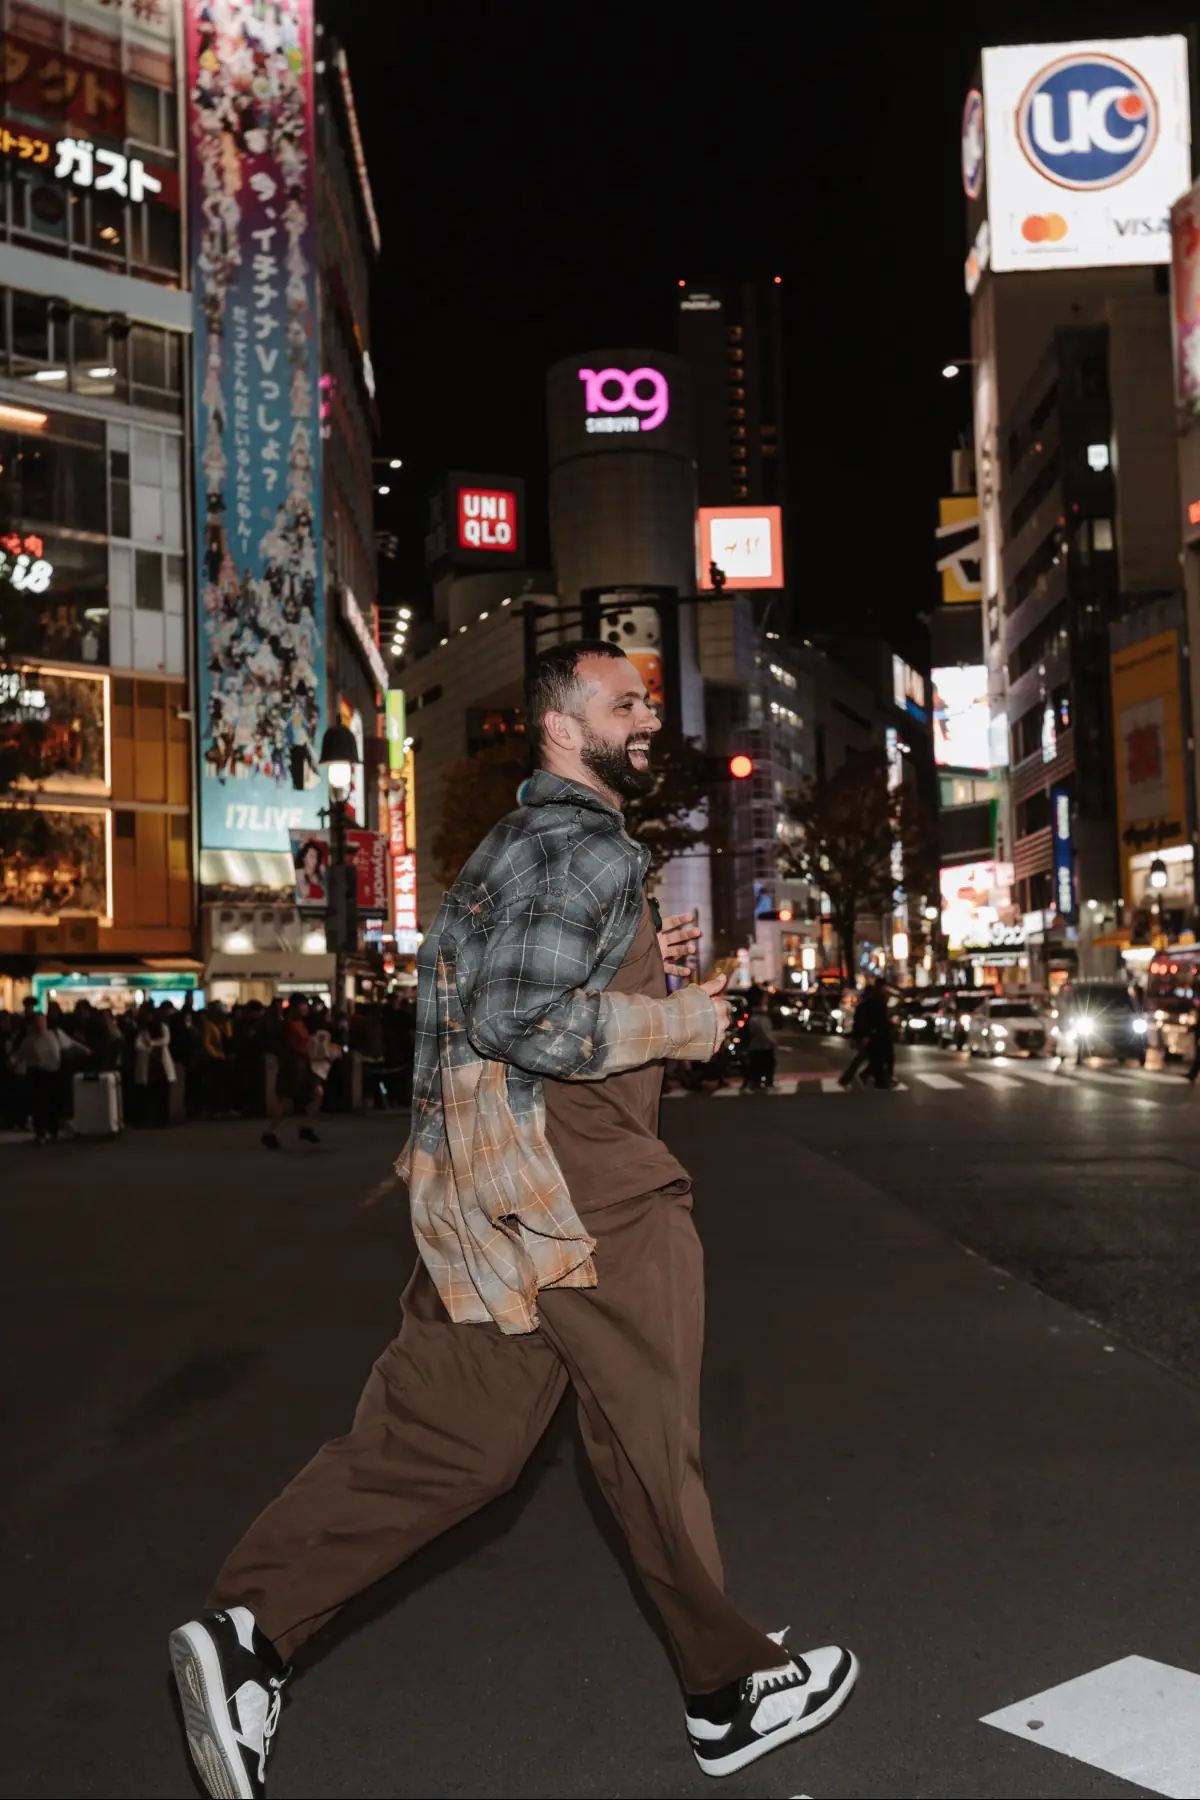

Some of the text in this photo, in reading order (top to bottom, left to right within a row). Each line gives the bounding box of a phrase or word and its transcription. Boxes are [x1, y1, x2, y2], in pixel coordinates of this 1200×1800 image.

[0, 127, 162, 203] トラン ガスト
[578, 367, 669, 431] 109
[463, 494, 508, 520] UNI
[464, 519, 512, 547] QLO
[225, 804, 304, 832] 17LIVE
